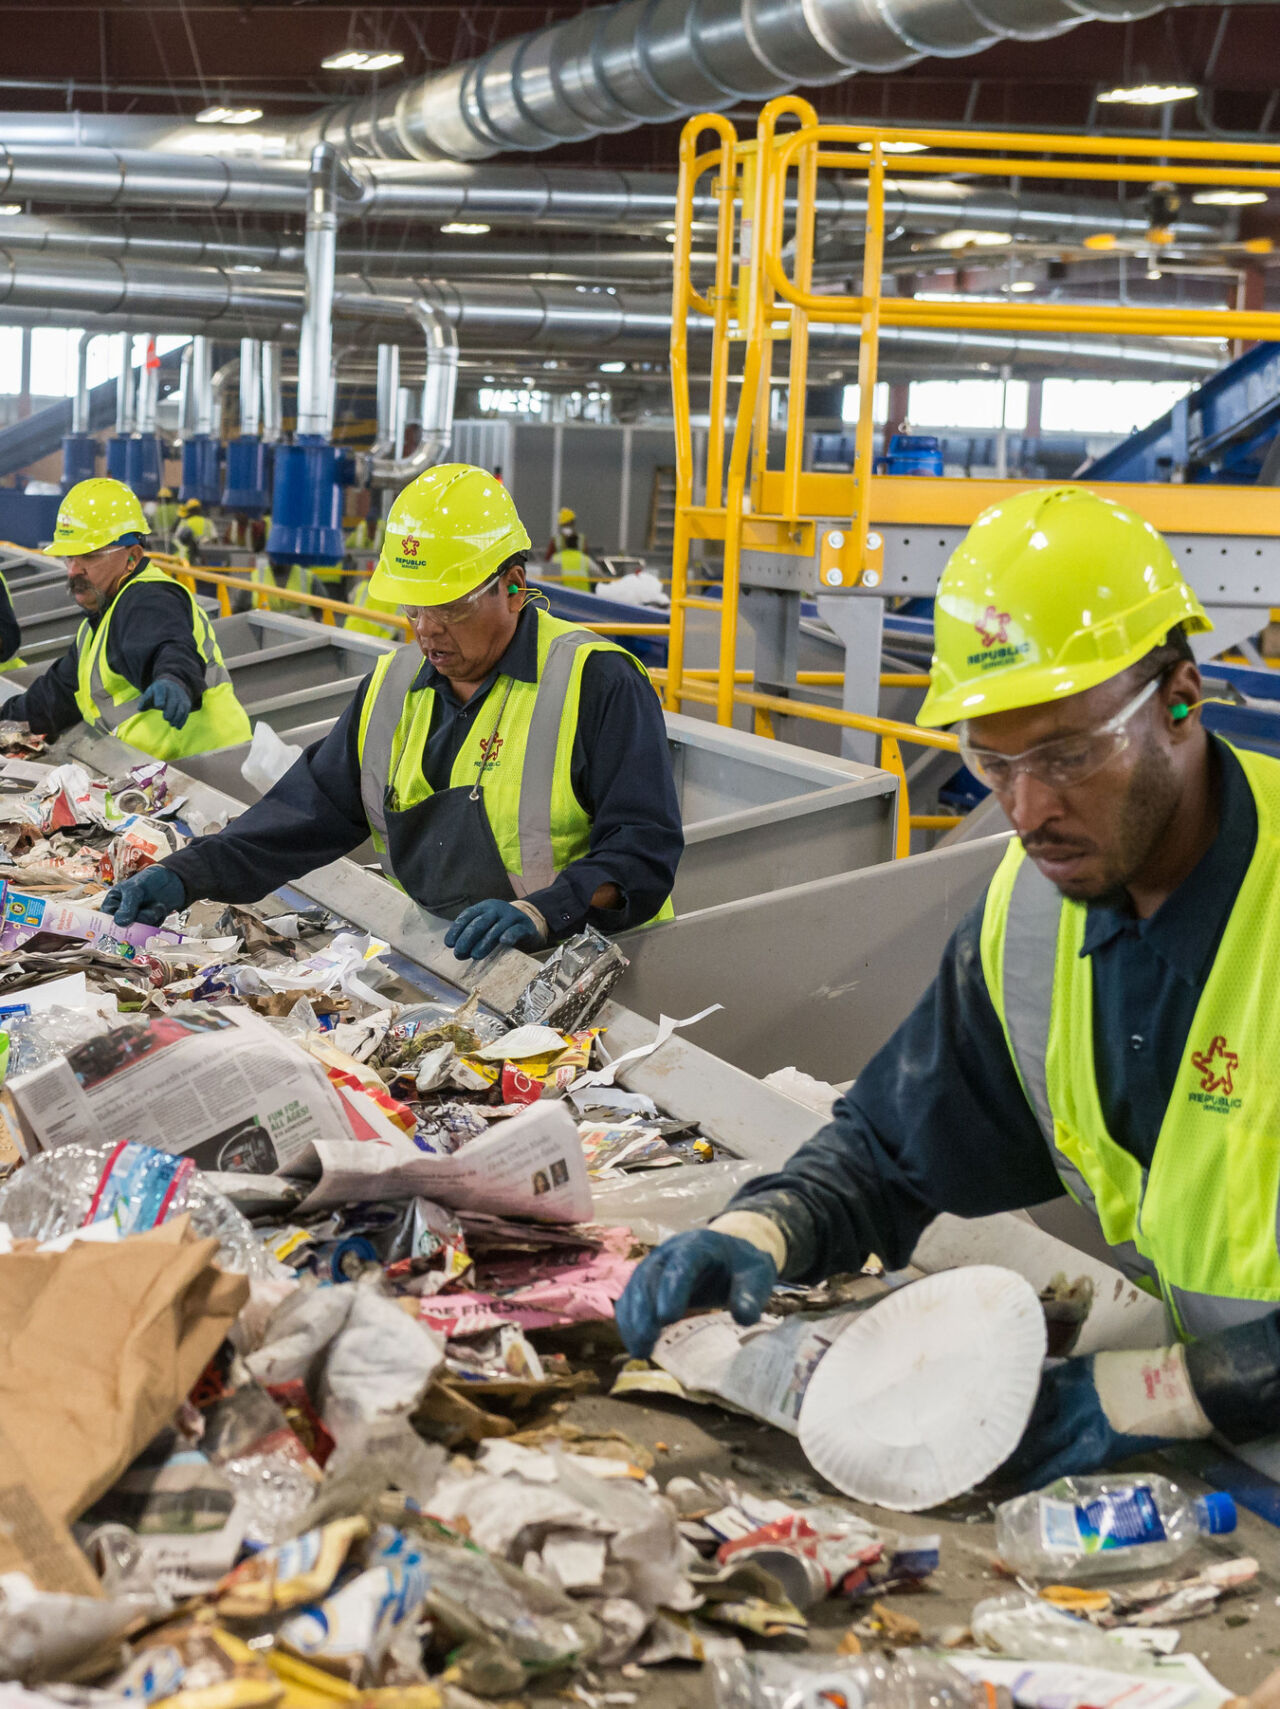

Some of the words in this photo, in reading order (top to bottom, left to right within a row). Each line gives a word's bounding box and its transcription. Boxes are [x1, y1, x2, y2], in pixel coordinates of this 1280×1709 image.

[395, 557, 427, 567] REPUBLIC
[966, 642, 1029, 665] REPUBLIC
[1188, 1092, 1242, 1108] REPUBLIC
[266, 1108, 283, 1123] FUN
[284, 1099, 300, 1114] FOR
[271, 1119, 285, 1132] ALL
